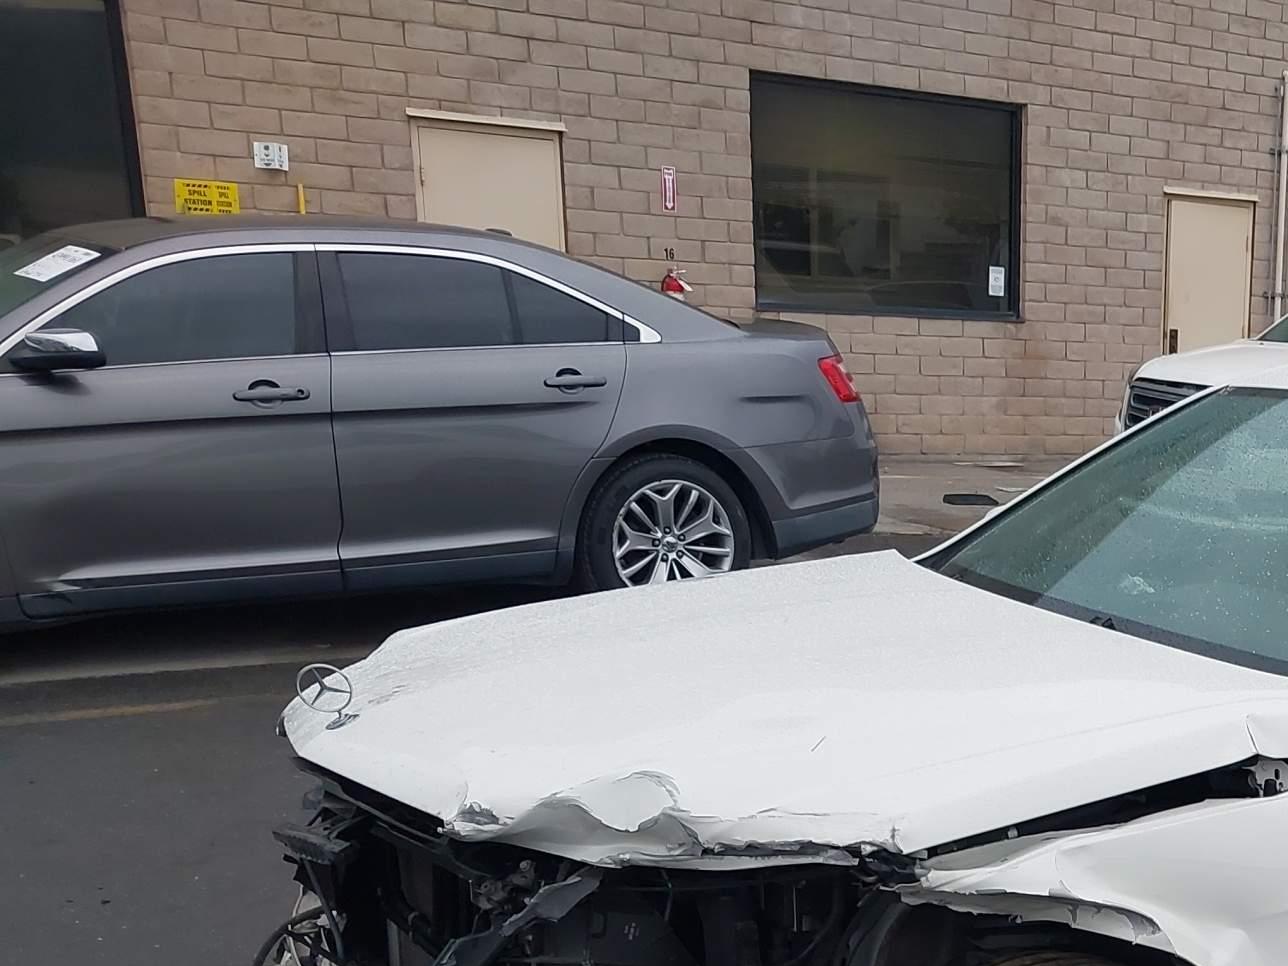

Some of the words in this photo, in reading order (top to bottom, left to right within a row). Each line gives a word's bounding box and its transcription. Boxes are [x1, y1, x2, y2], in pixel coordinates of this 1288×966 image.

[187, 189, 207, 197] SPILL
[184, 198, 212, 206] STATION
[664, 248, 675, 260] 16
